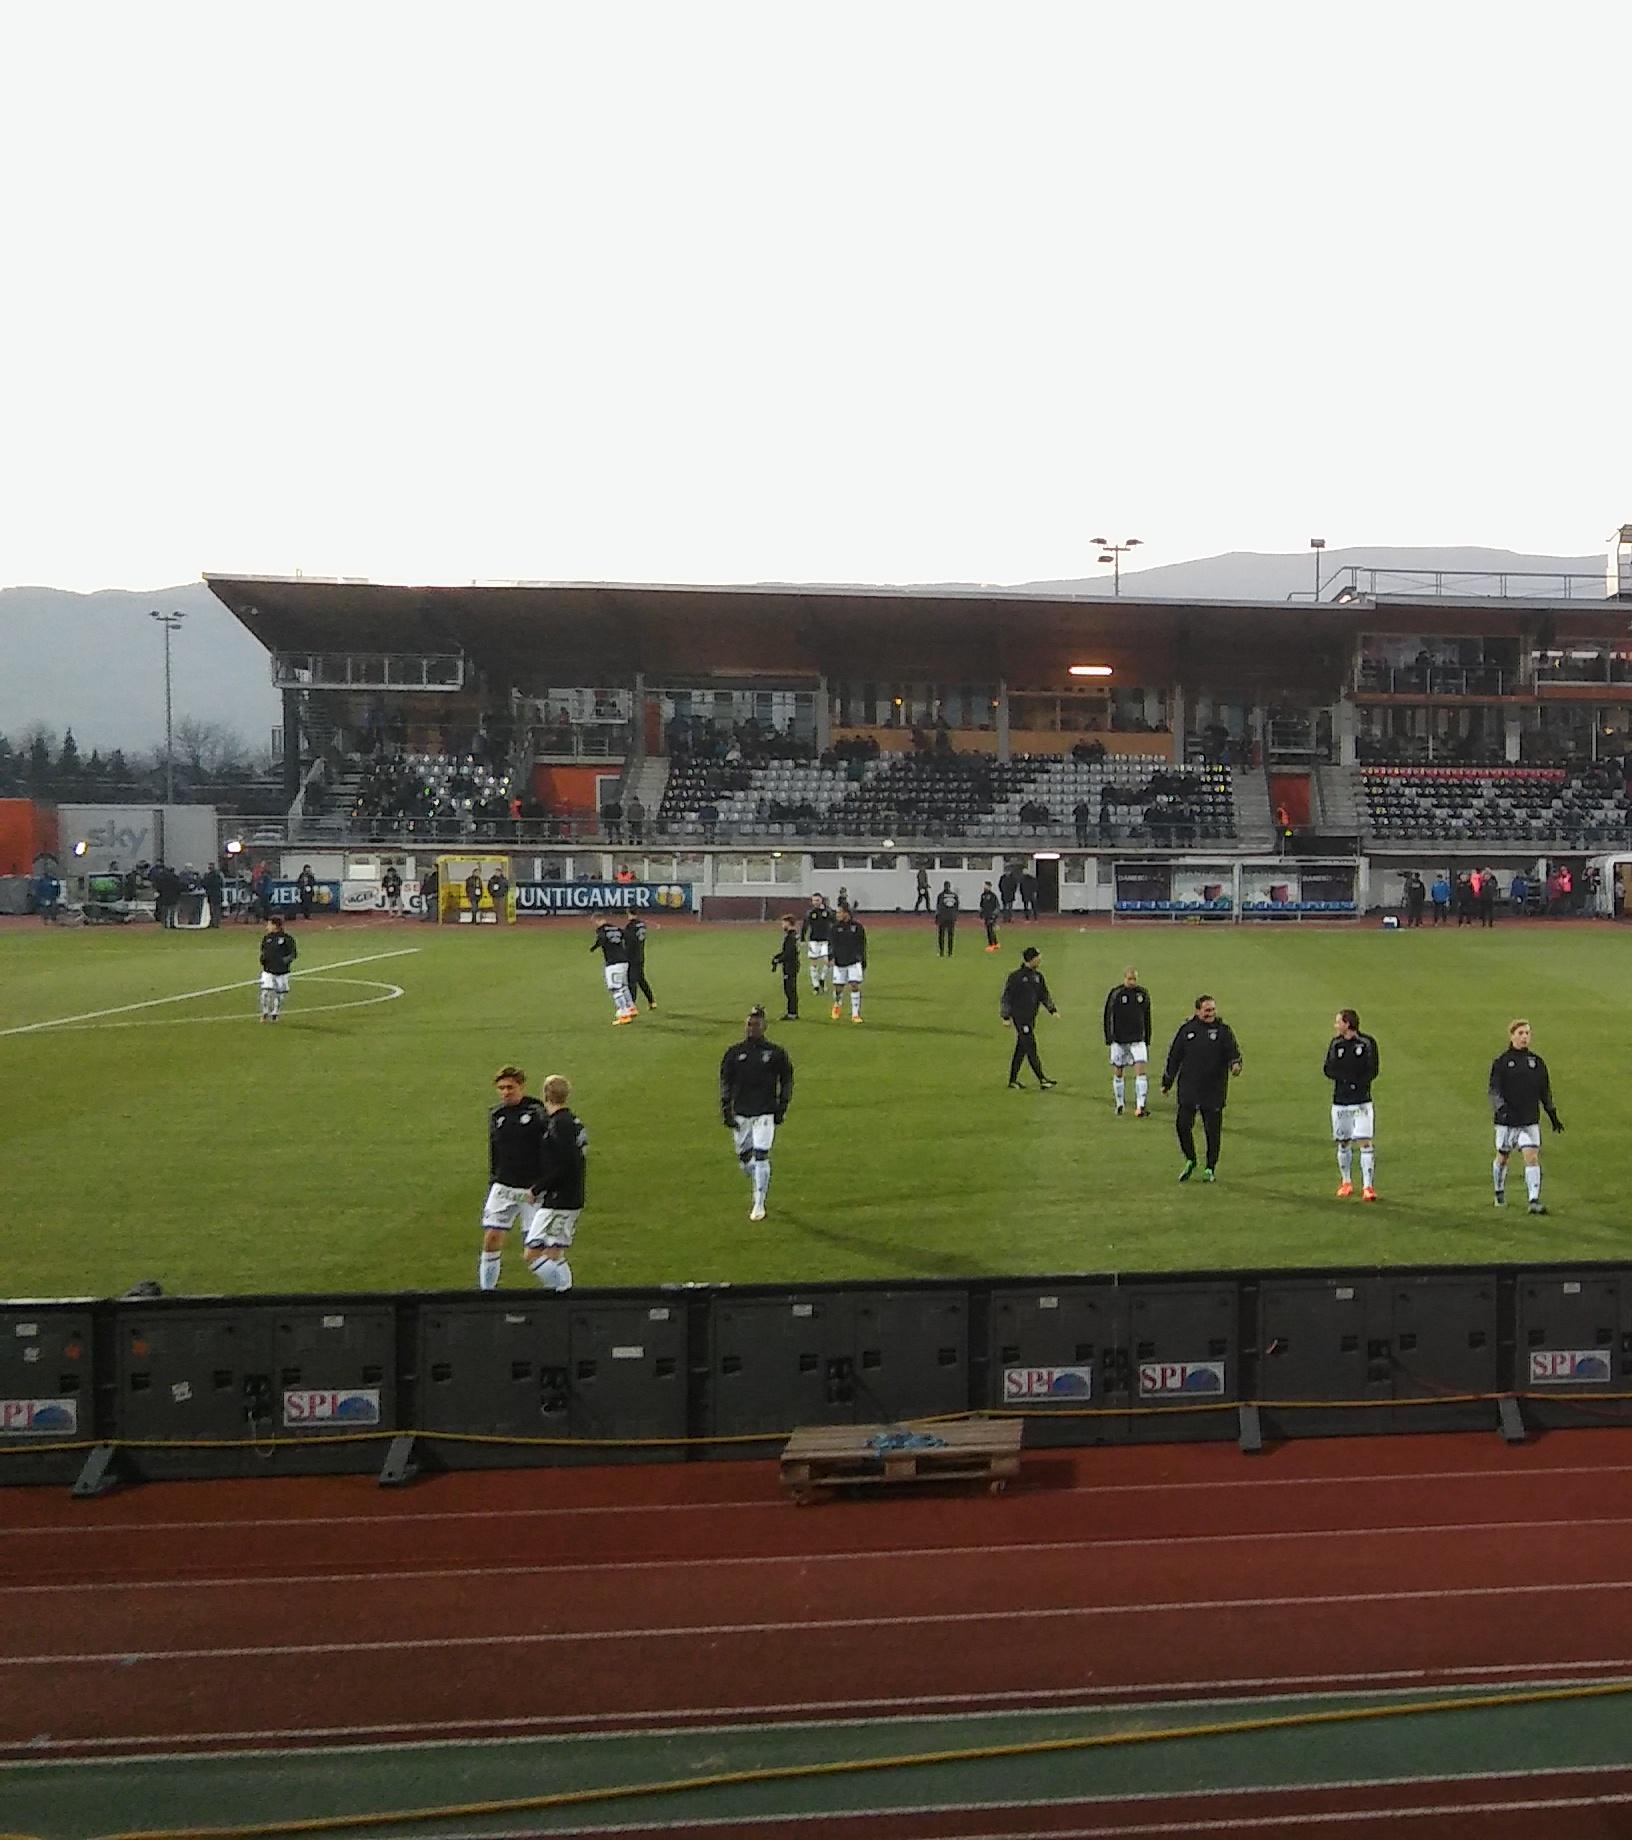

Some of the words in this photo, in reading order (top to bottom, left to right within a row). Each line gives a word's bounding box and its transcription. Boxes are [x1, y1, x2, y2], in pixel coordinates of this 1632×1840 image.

[88, 819, 148, 851] sky
[1534, 1354, 1576, 1376] SPI
[1007, 1370, 1054, 1393] SPI
[1142, 1366, 1187, 1388] SPI
[0, 1403, 33, 1427] PI
[286, 1391, 338, 1416] SPI
